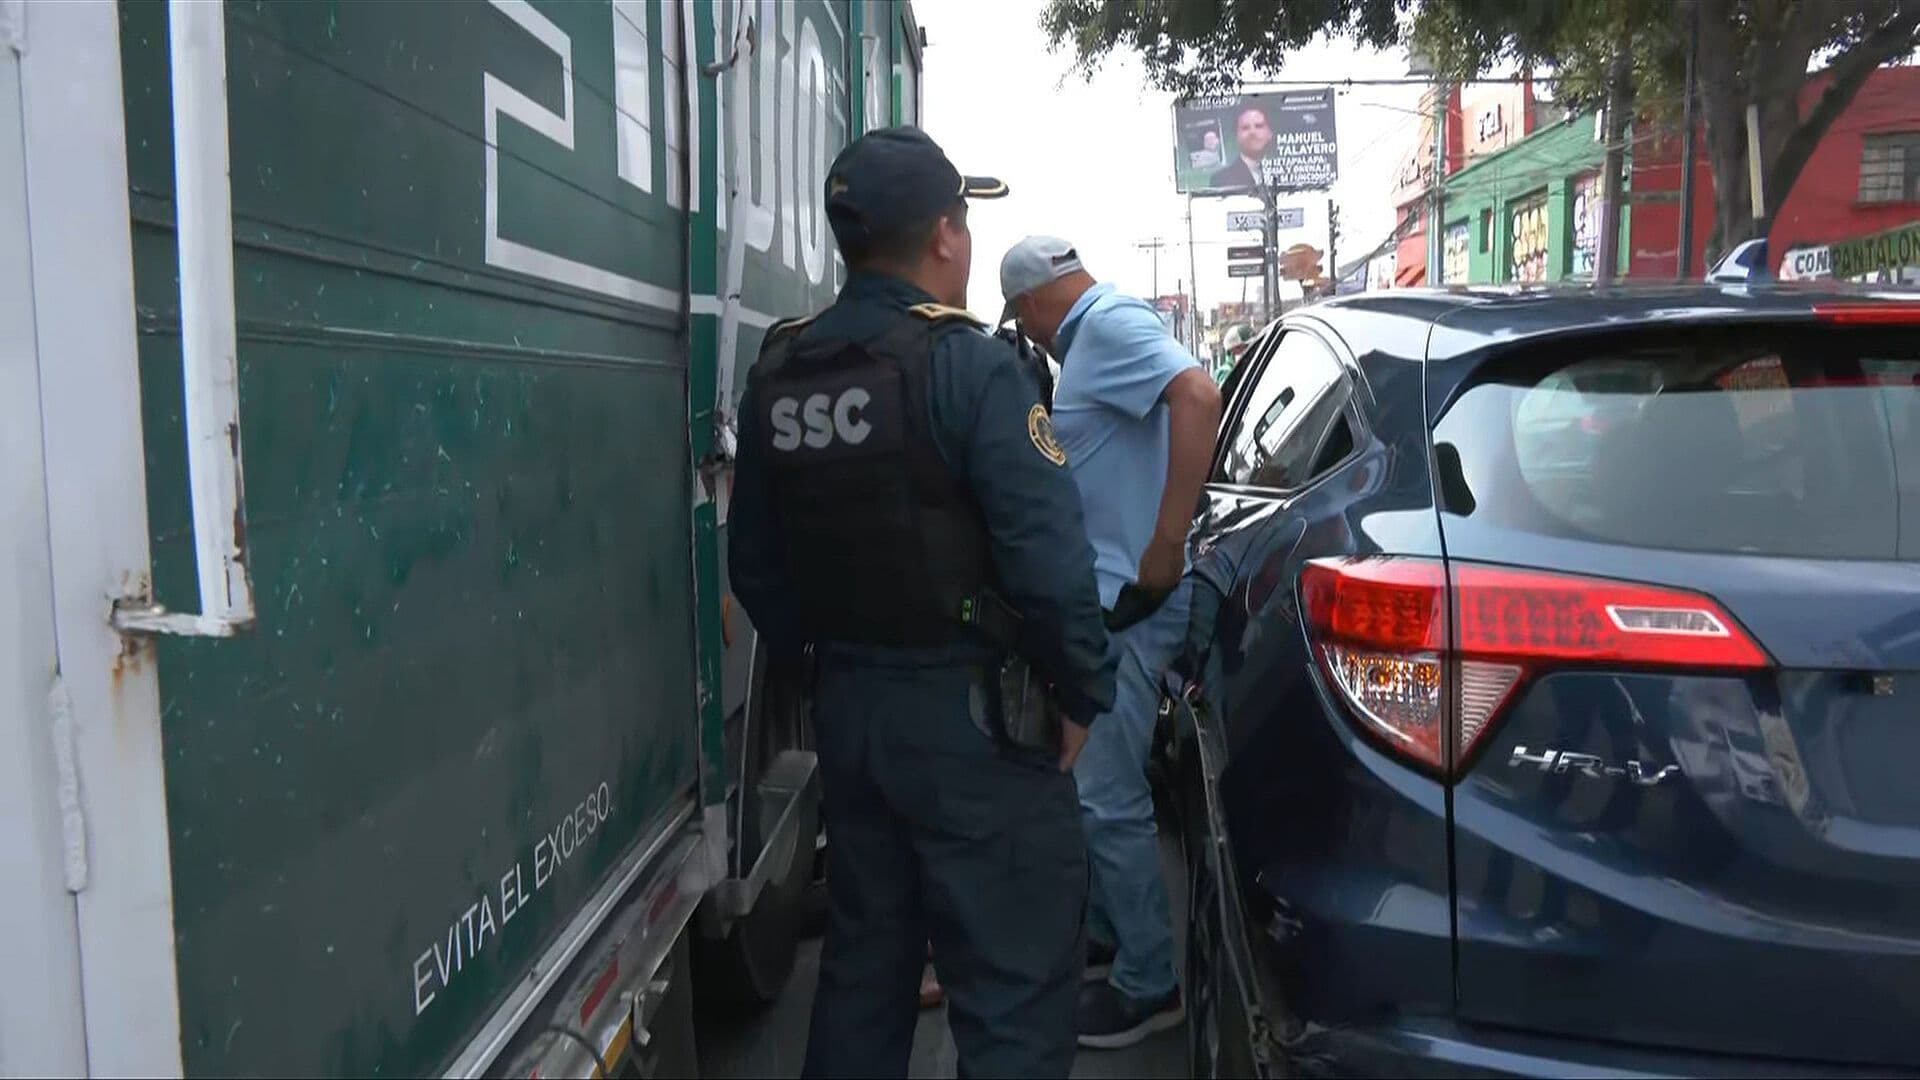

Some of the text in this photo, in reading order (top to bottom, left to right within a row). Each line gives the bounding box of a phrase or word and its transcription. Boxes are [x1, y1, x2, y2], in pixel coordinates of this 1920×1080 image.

[1277, 131, 1325, 144] MANUEL
[1278, 142, 1336, 156] TALAYERO
[770, 387, 872, 451] SSC
[1508, 745, 1680, 785] HR-V
[413, 894, 496, 1016] EVITA
[501, 863, 530, 924] EL
